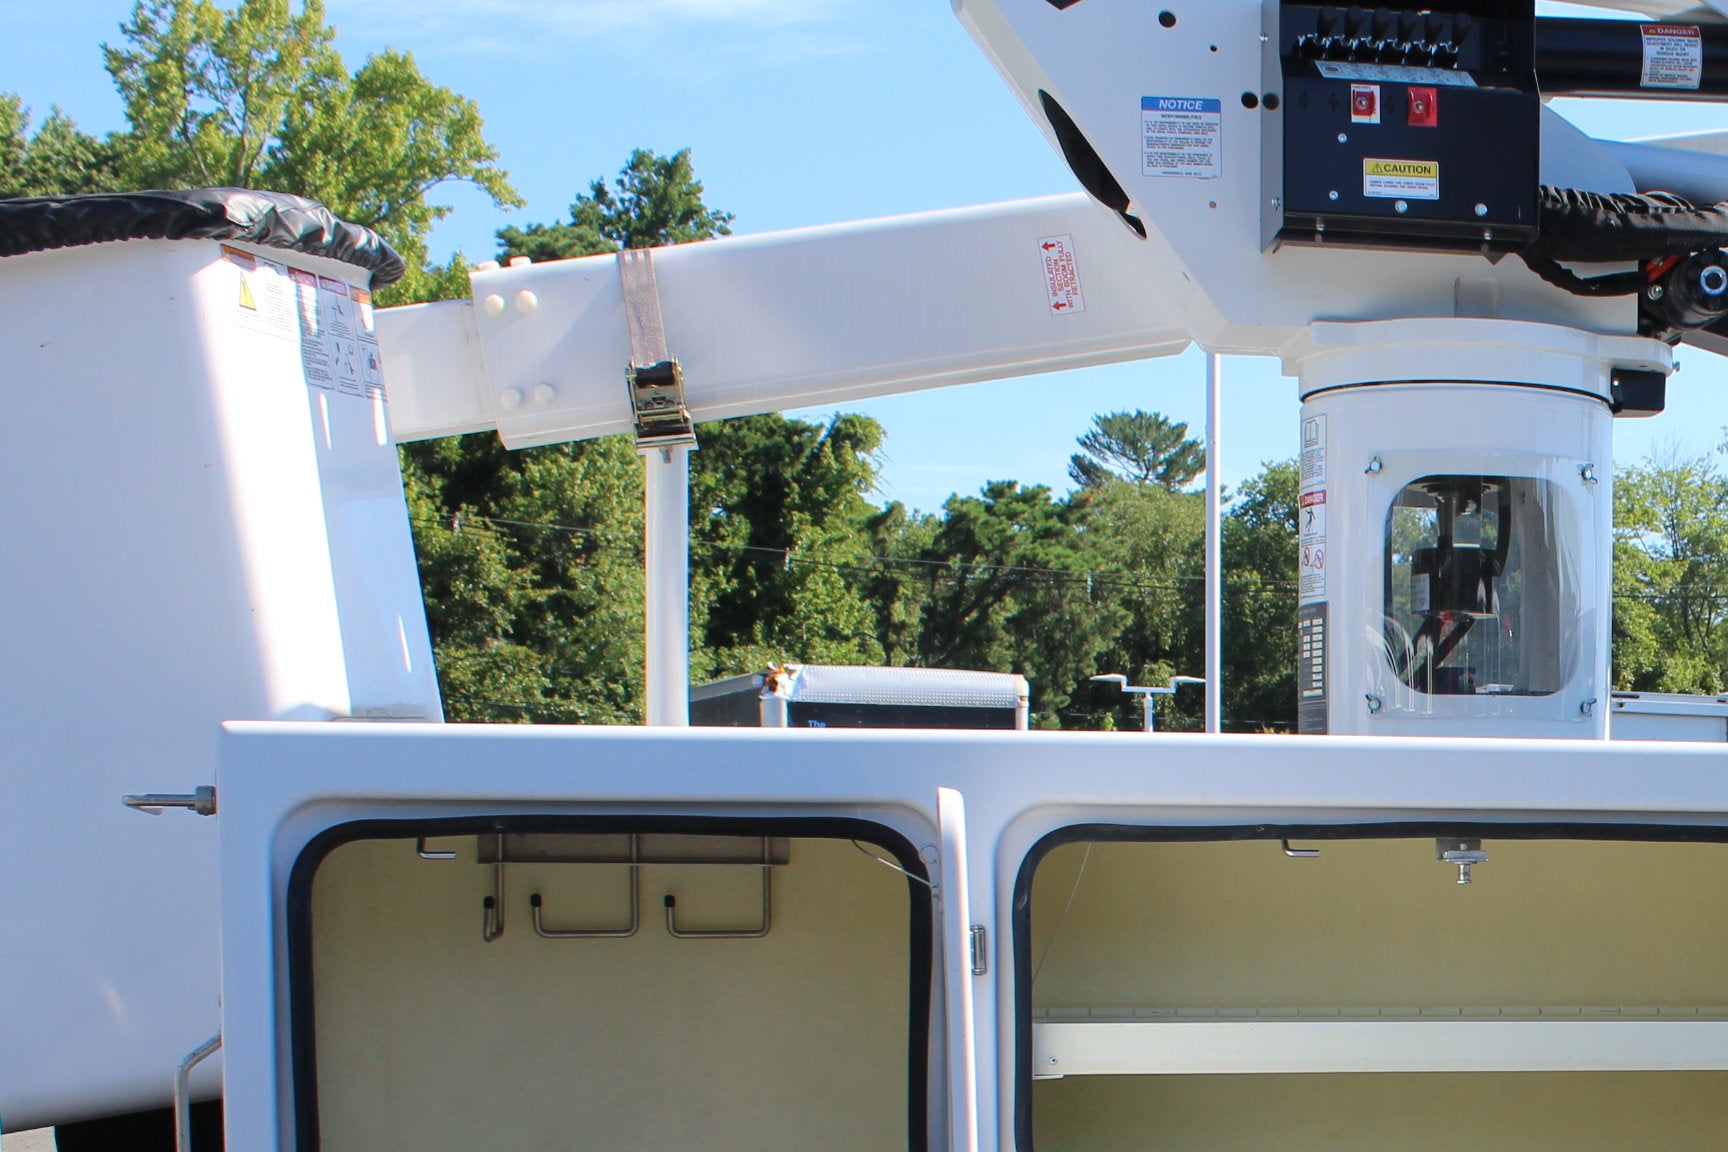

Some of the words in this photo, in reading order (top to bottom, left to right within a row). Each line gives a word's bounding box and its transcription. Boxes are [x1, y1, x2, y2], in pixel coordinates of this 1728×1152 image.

[1657, 28, 1695, 36] DANGER
[1158, 99, 1204, 110] NOTICE
[1383, 163, 1431, 174] CAUTION
[1056, 240, 1065, 262] FULLY
[1045, 256, 1058, 297] INSULATED
[1053, 258, 1064, 292] SECTION
[1061, 264, 1070, 288] BOOM
[1065, 252, 1079, 296] RETRACTED
[1065, 290, 1075, 309] WITH
[808, 719, 827, 728] The
